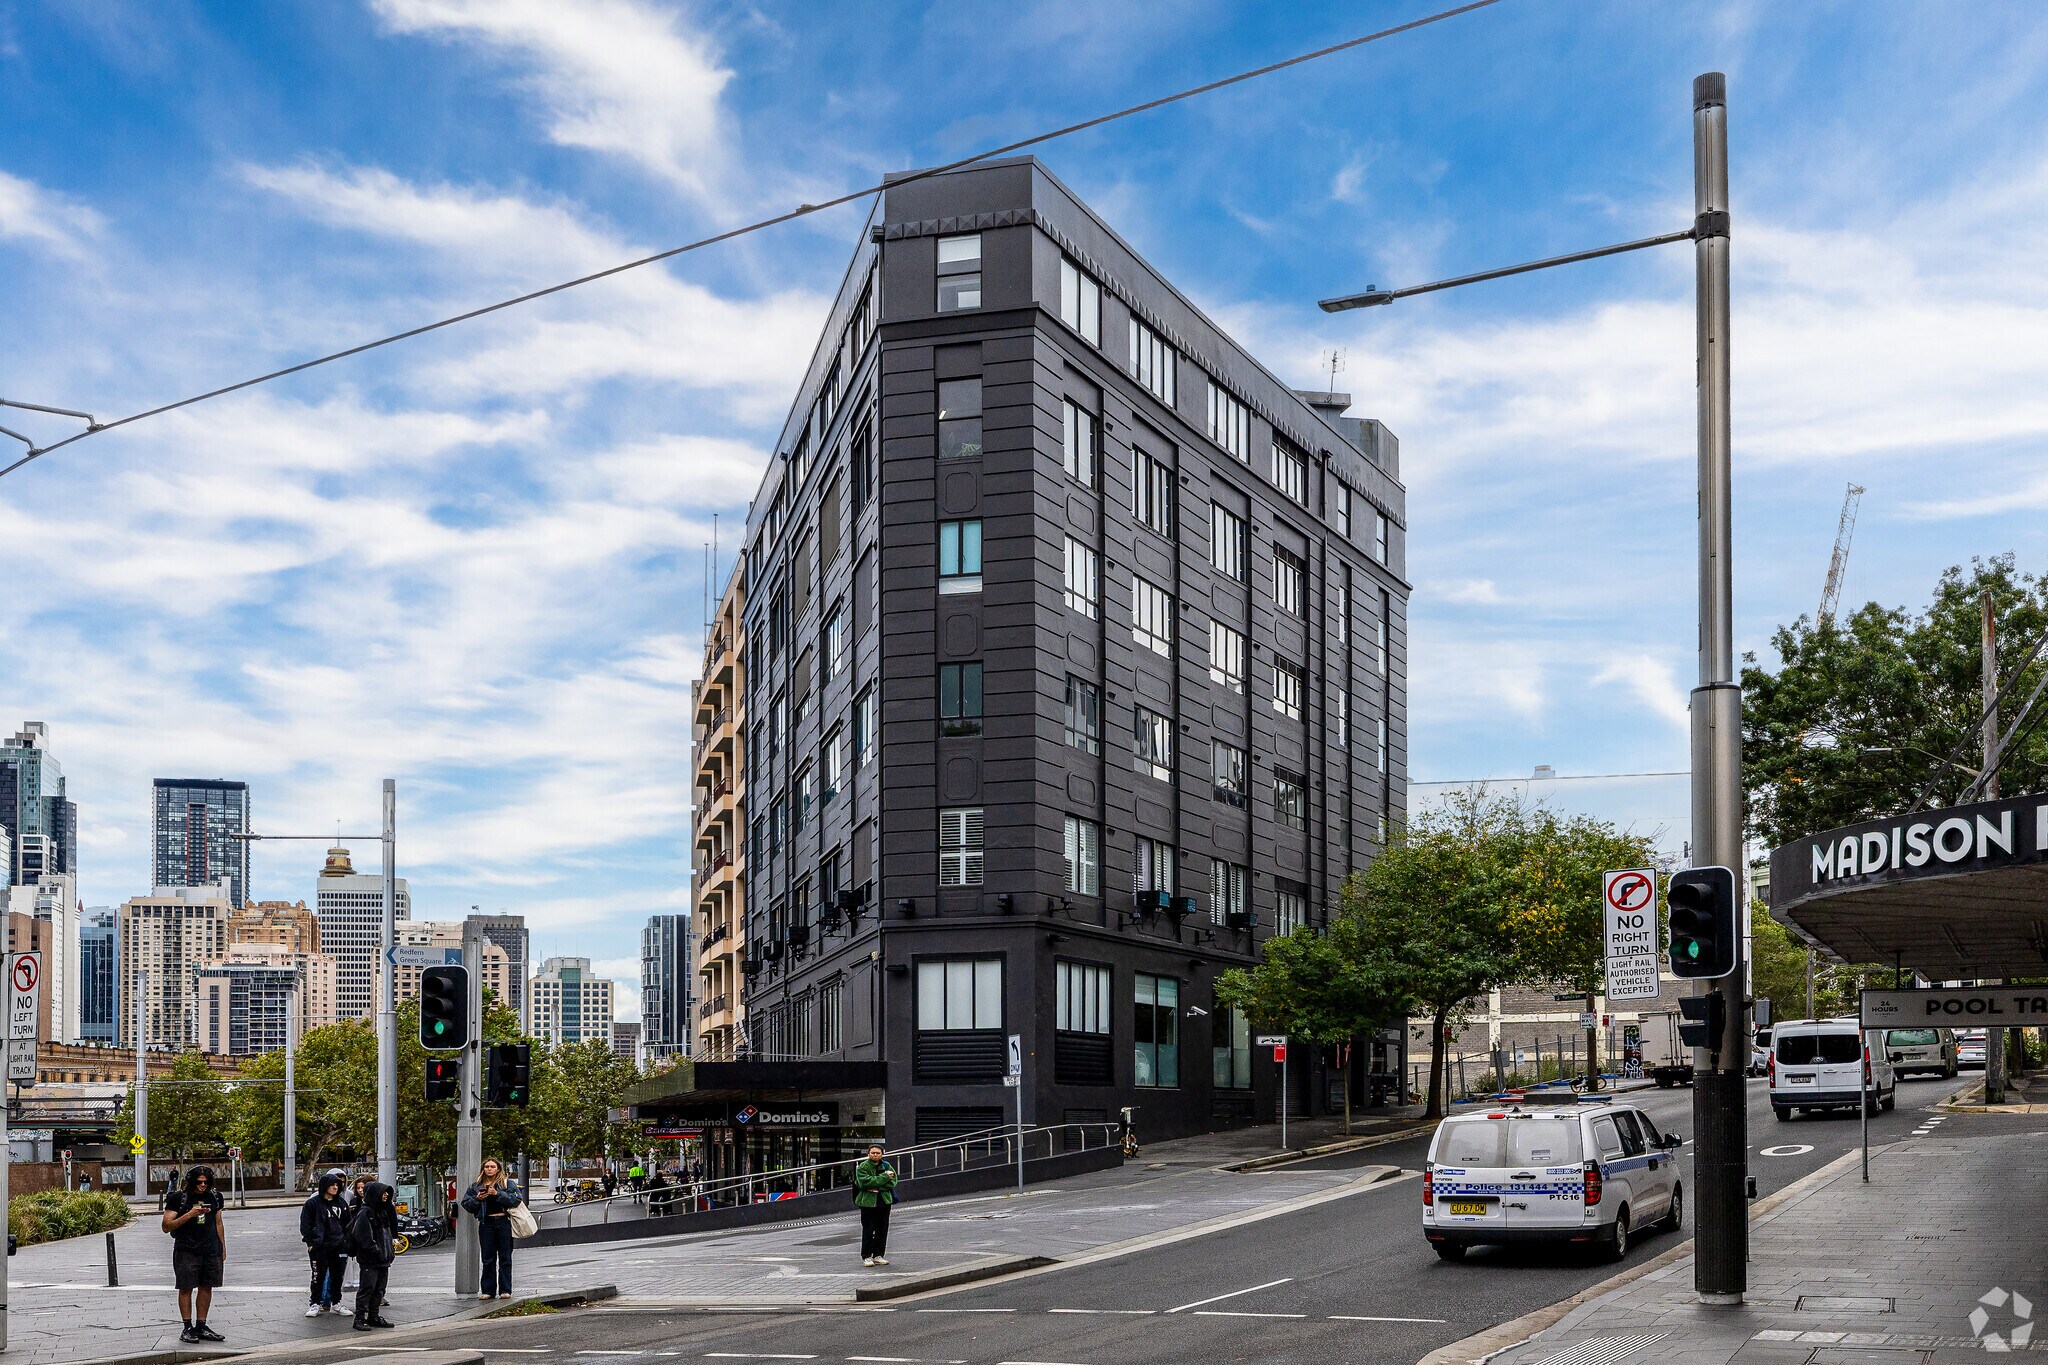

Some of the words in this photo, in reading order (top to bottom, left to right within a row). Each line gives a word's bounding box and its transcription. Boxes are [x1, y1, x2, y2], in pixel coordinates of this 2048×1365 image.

[1812, 810, 2014, 884] MADISON
[1617, 914, 1644, 929] NO
[1612, 931, 1650, 943] RIGHT
[400, 948, 424, 956] Redfern
[1614, 945, 1649, 956] TURN
[400, 956, 419, 964] Green
[420, 957, 442, 965] Square
[1611, 960, 1633, 969] LIGHT
[1635, 958, 1652, 967] RAIL
[1610, 967, 1655, 978] AUTHORISED
[1615, 976, 1651, 986] VEHICLE
[1612, 985, 1654, 995] EXCEPTED
[17, 995, 33, 1010] NO
[1926, 998, 2003, 1016] POOL
[2013, 997, 2048, 1014] TA
[14, 1012, 33, 1022] LEFT
[13, 1025, 33, 1035] TURN
[19, 1042, 26, 1050] AT
[10, 1054, 23, 1063] LIGHT
[24, 1053, 35, 1062] RAIL
[12, 1066, 33, 1075] TRACK
[679, 1117, 729, 1127] Domino's
[759, 1111, 829, 1123] Domino's
[1465, 1183, 1503, 1191] Police
[1509, 1183, 1526, 1191] 131
[1529, 1183, 1548, 1191] 444
